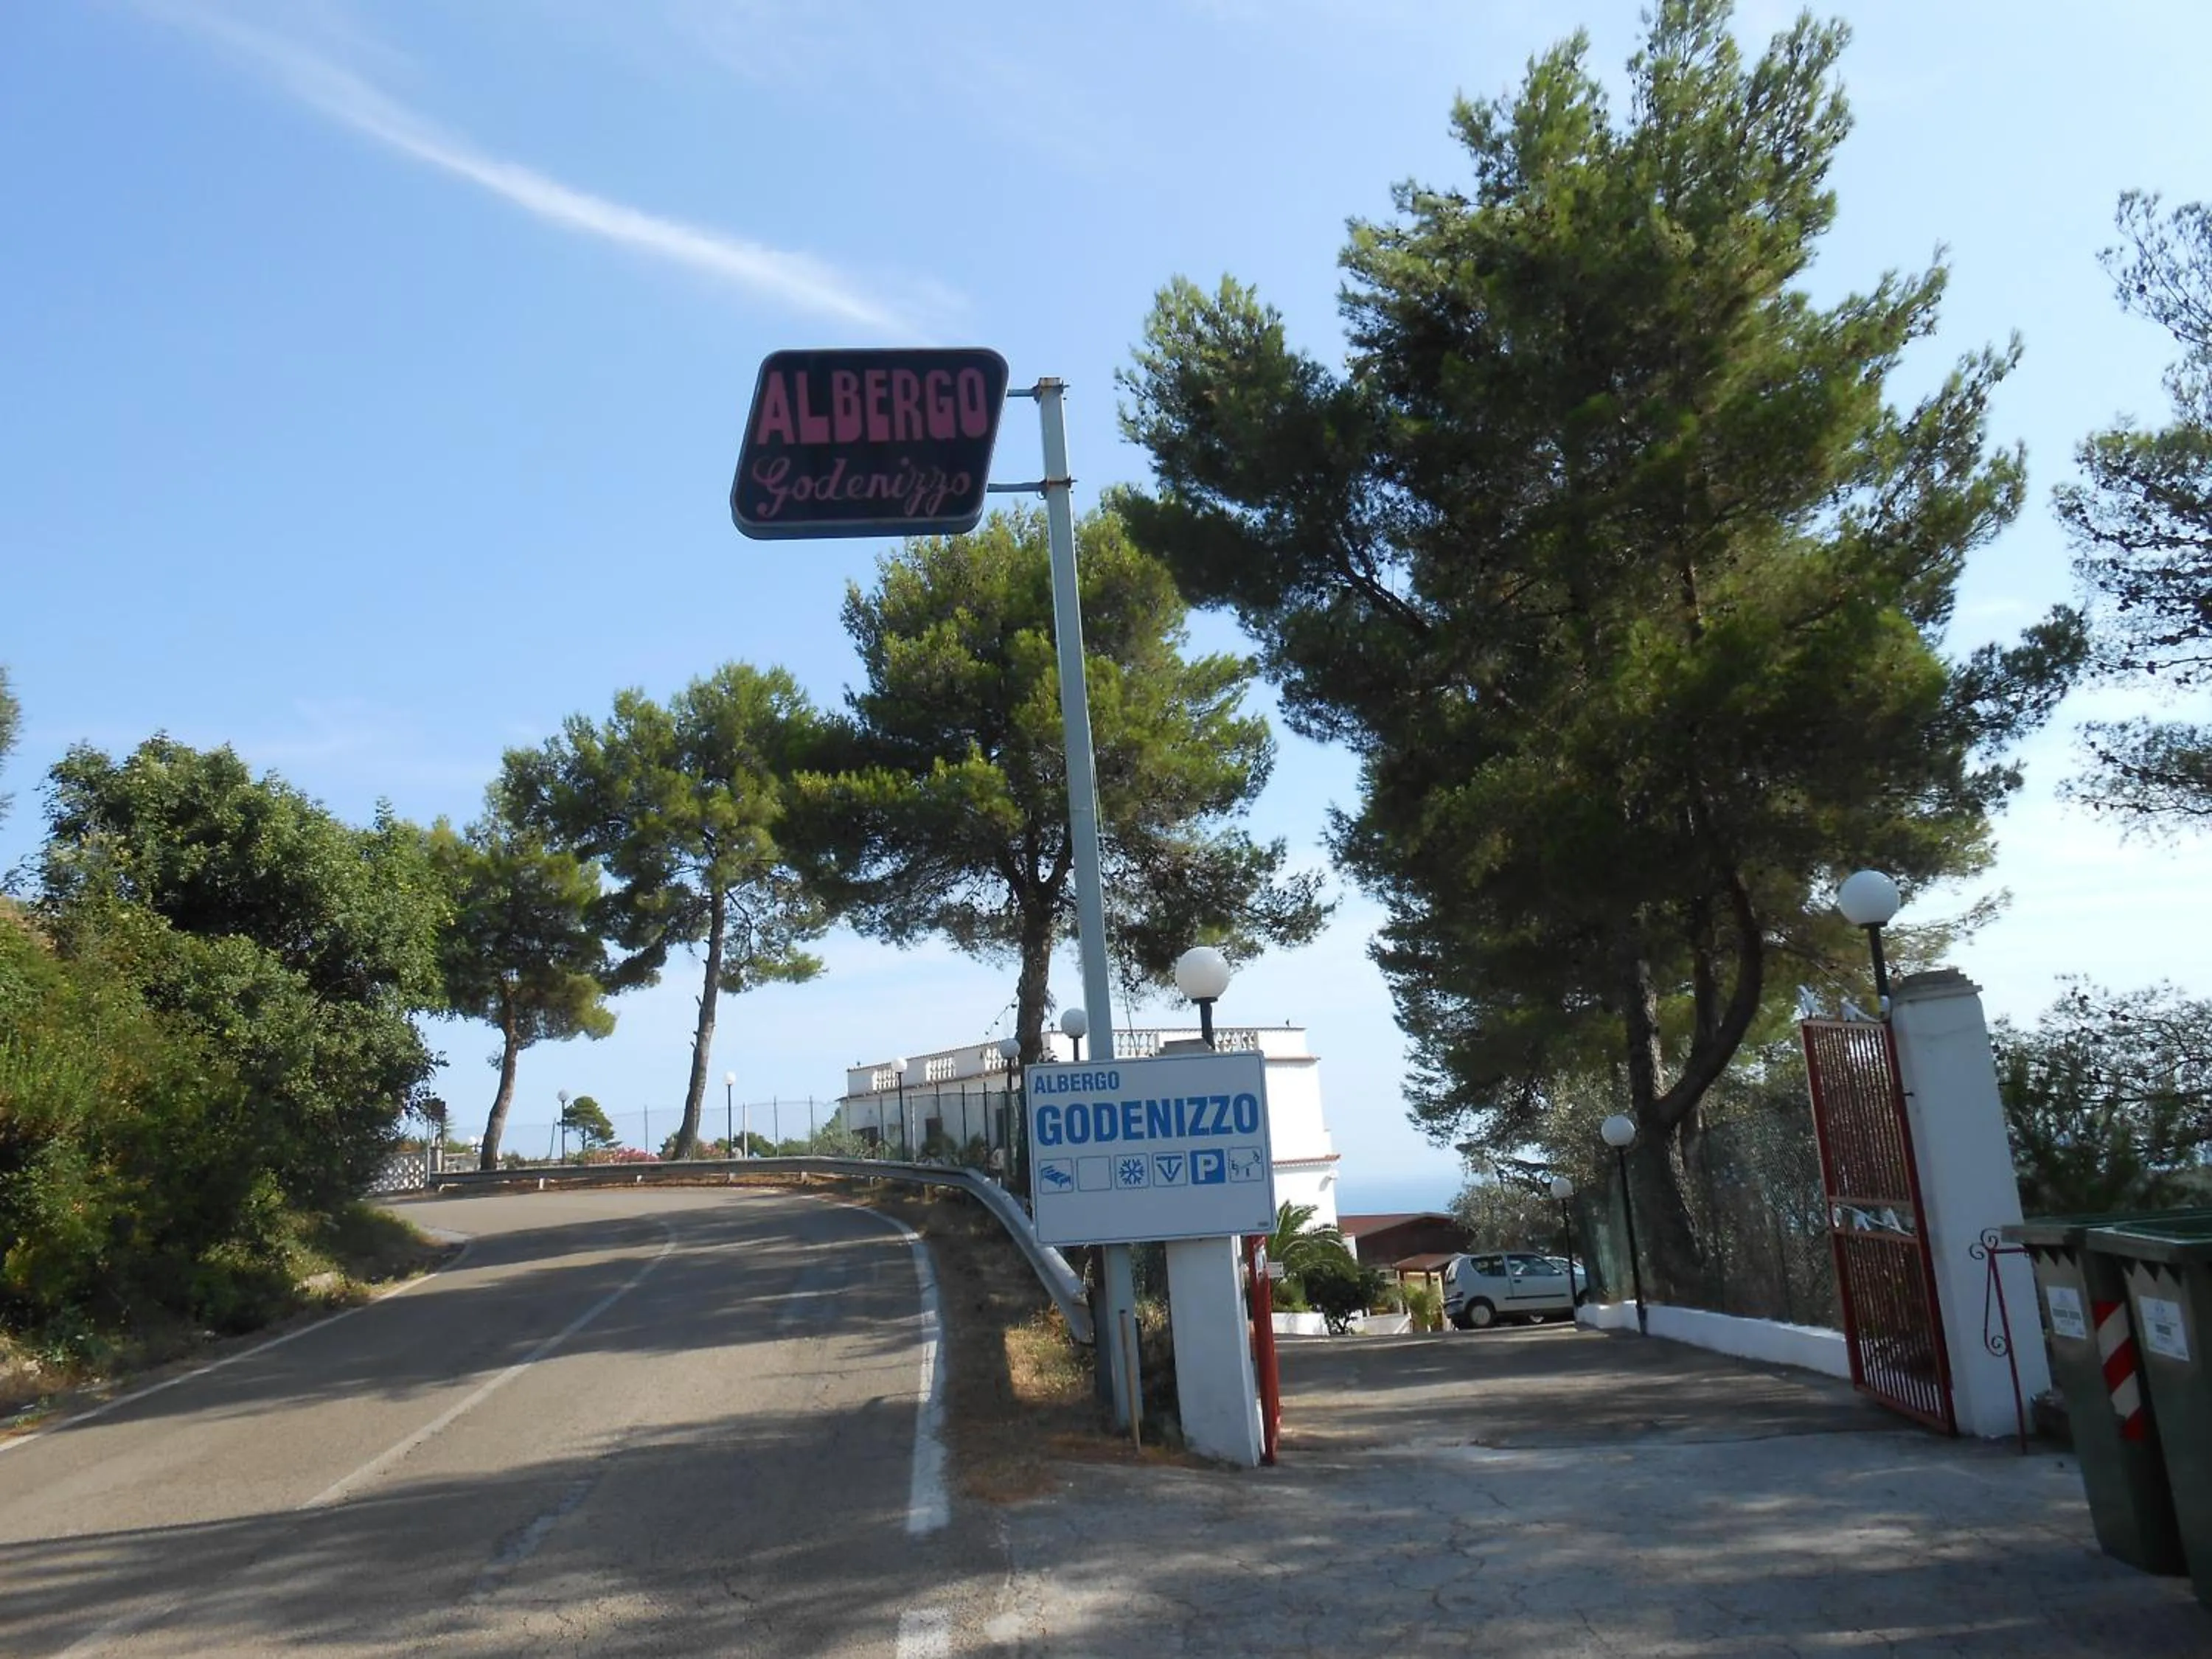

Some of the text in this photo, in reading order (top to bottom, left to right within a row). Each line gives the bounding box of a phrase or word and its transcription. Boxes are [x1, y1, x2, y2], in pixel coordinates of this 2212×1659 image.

[757, 368, 988, 445] ALBERGO
[751, 455, 972, 516] Godenizzo
[1034, 1071, 1120, 1094] ALBERGO
[1036, 1093, 1259, 1147] GODENIZZO
[1197, 1155, 1219, 1180] P
